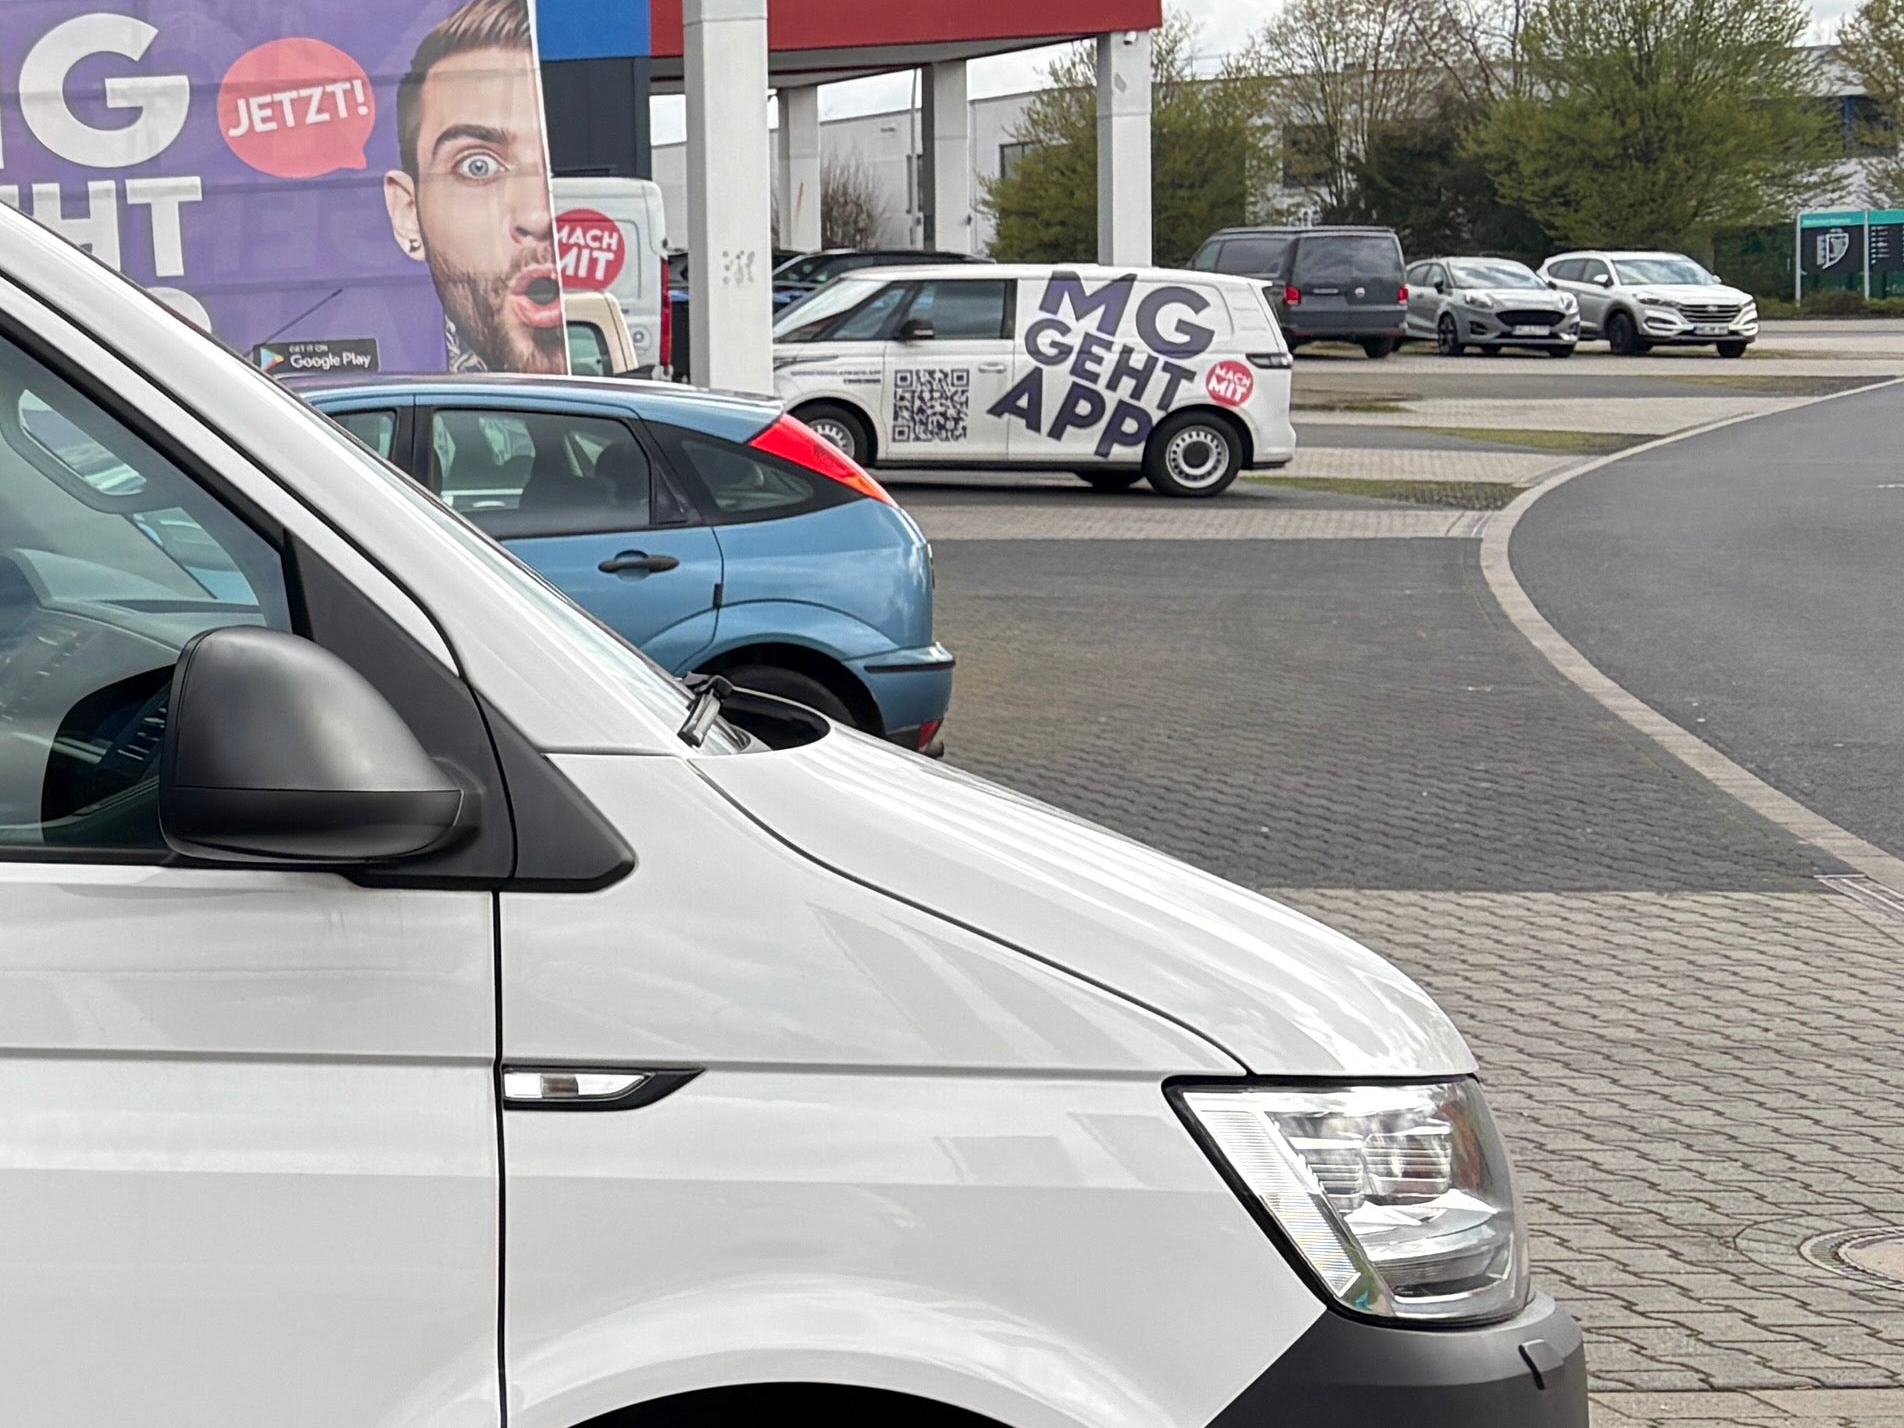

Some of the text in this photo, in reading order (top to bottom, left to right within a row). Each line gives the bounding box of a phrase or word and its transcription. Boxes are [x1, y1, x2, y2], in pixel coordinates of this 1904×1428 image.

[228, 79, 369, 137] JETZT!
[1038, 270, 1215, 359] MG
[290, 351, 371, 370] Google Play
[1024, 318, 1196, 413] GEHT
[1208, 374, 1247, 402] MIT
[986, 366, 1156, 459] APP
